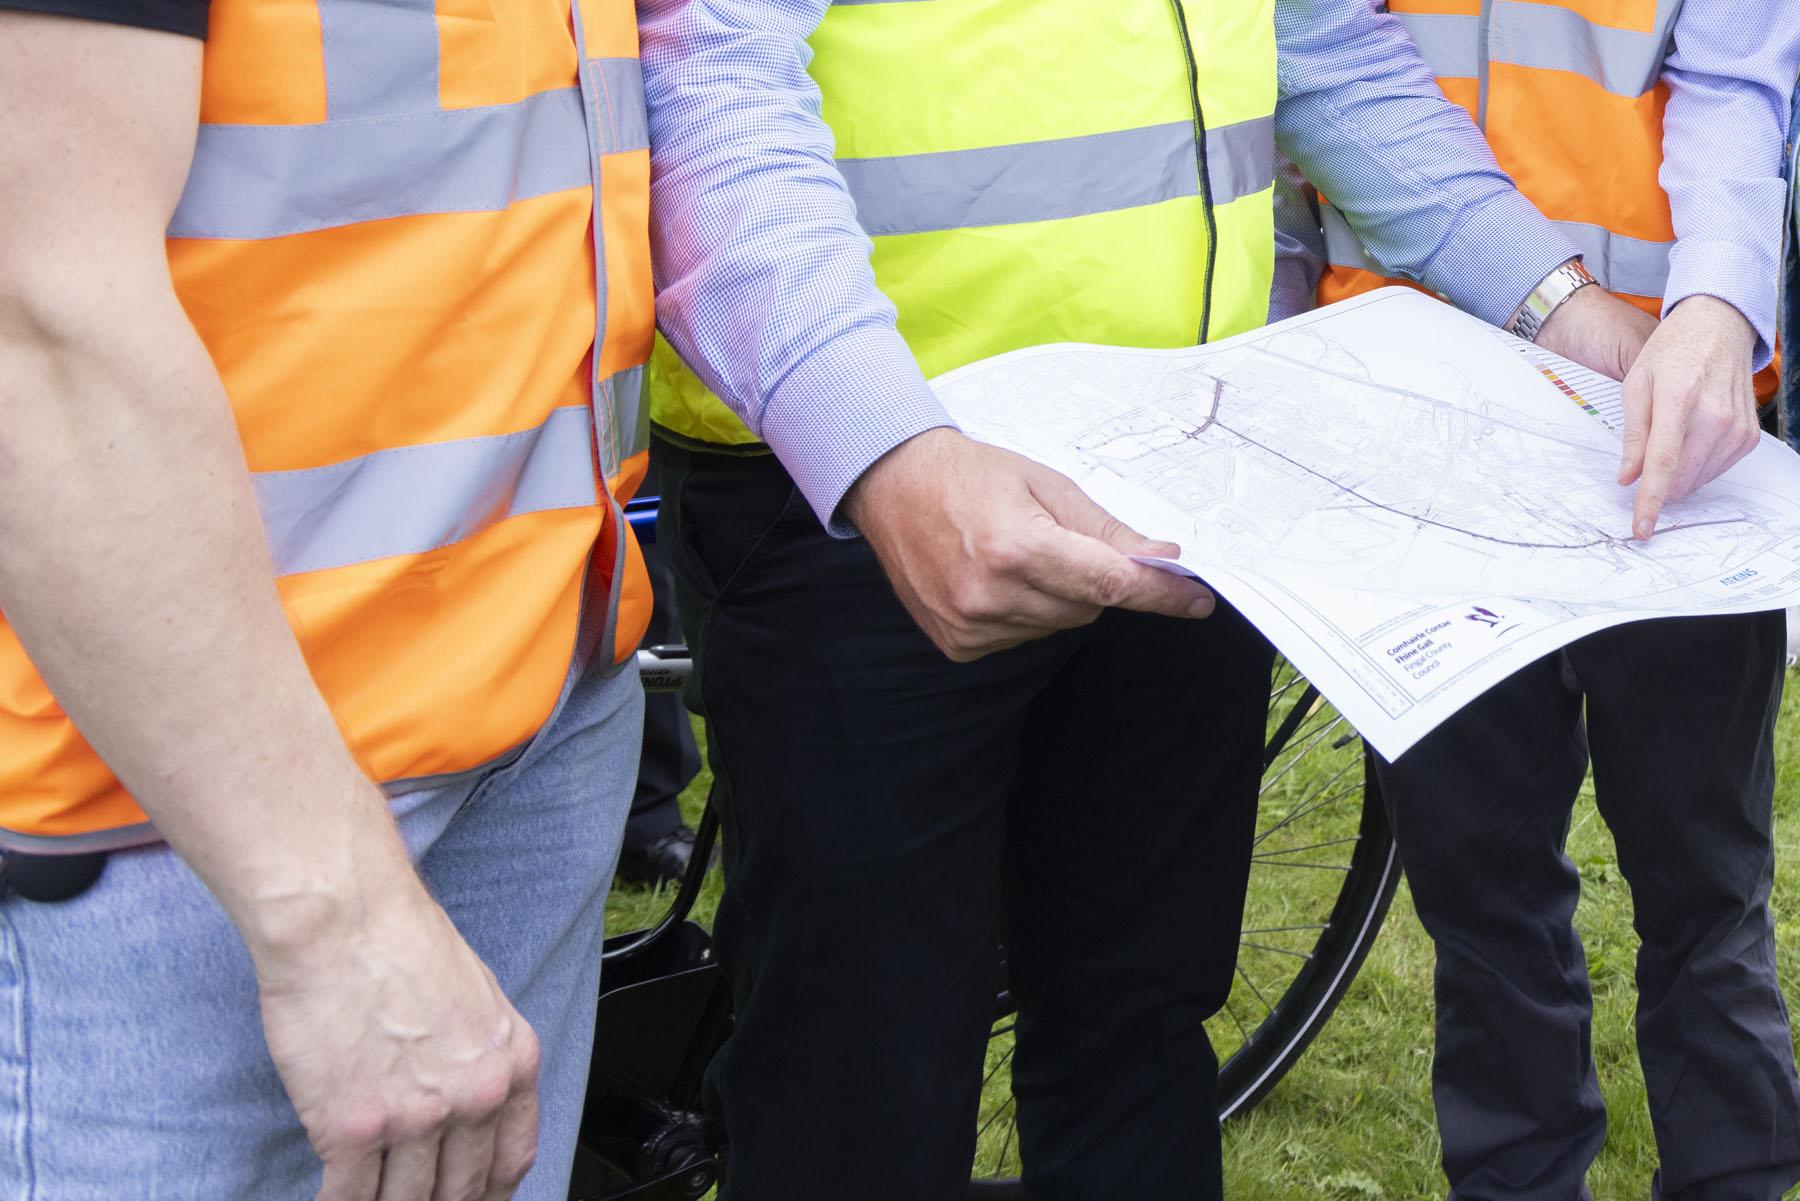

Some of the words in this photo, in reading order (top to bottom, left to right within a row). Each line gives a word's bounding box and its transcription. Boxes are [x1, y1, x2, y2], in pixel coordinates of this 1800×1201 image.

[1719, 568, 1758, 587] ATKINS
[1386, 631, 1427, 657] Comhairle
[1425, 619, 1452, 635] Contae
[1394, 648, 1419, 665] Fhine
[1417, 639, 1434, 651] Gall
[1403, 655, 1427, 673] Fingal
[1425, 641, 1453, 659] County
[1412, 659, 1441, 680] Council
